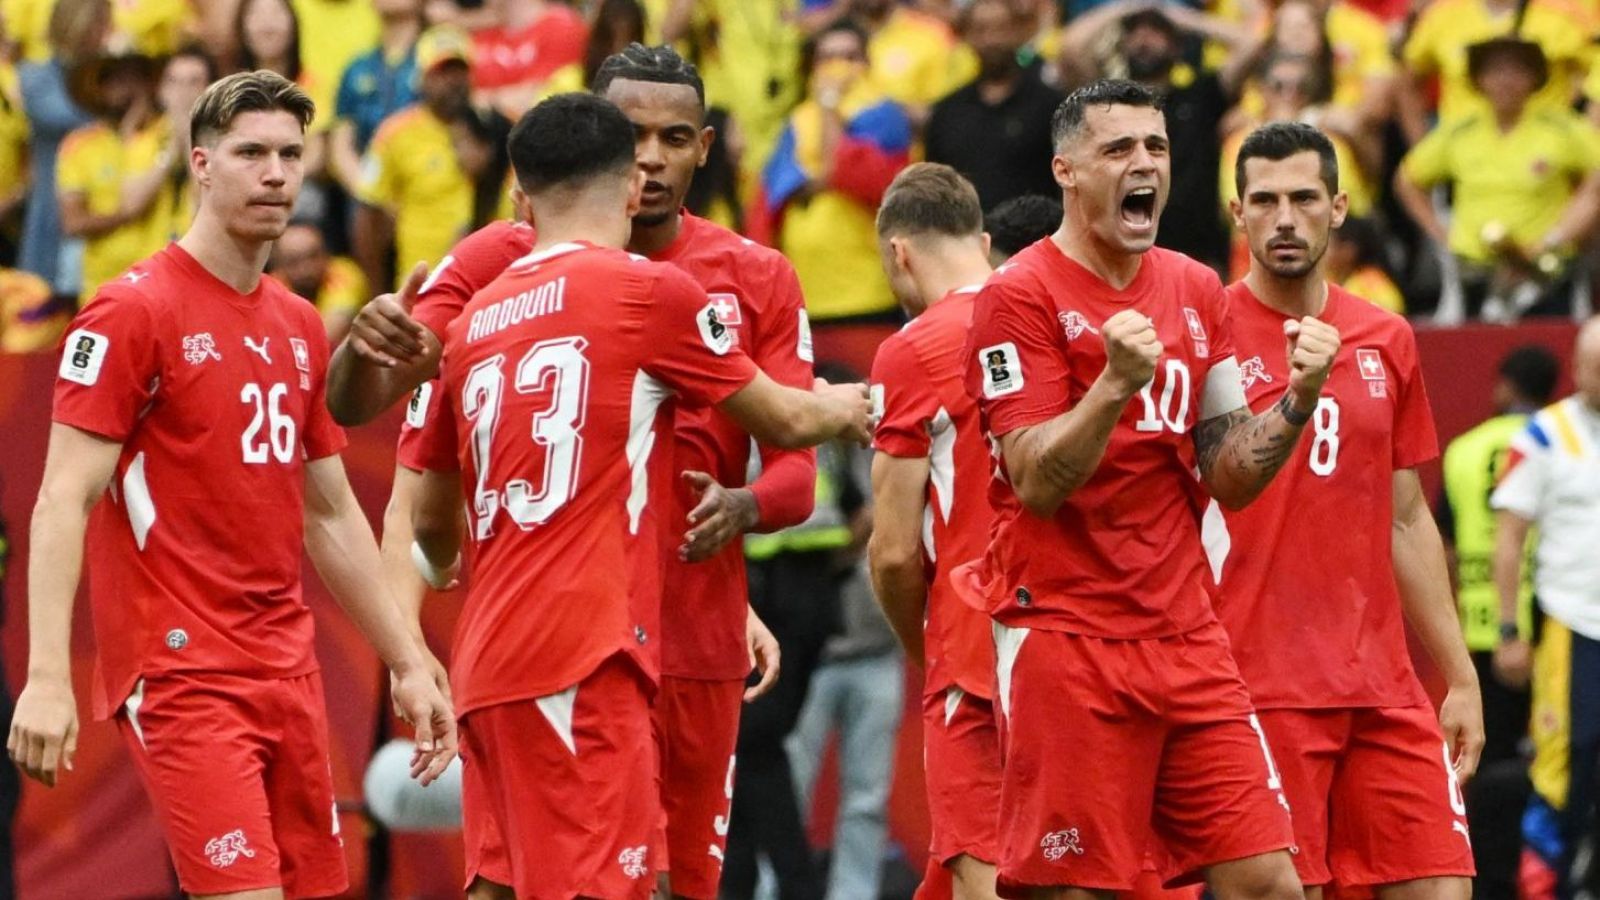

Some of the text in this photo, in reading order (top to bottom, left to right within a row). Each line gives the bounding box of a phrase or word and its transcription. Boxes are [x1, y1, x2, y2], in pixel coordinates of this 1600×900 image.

[466, 276, 566, 345] AMDOUNI
[240, 382, 296, 464] 26
[1135, 358, 1190, 434] 10
[462, 336, 590, 542] 23
[1308, 397, 1340, 476] 8
